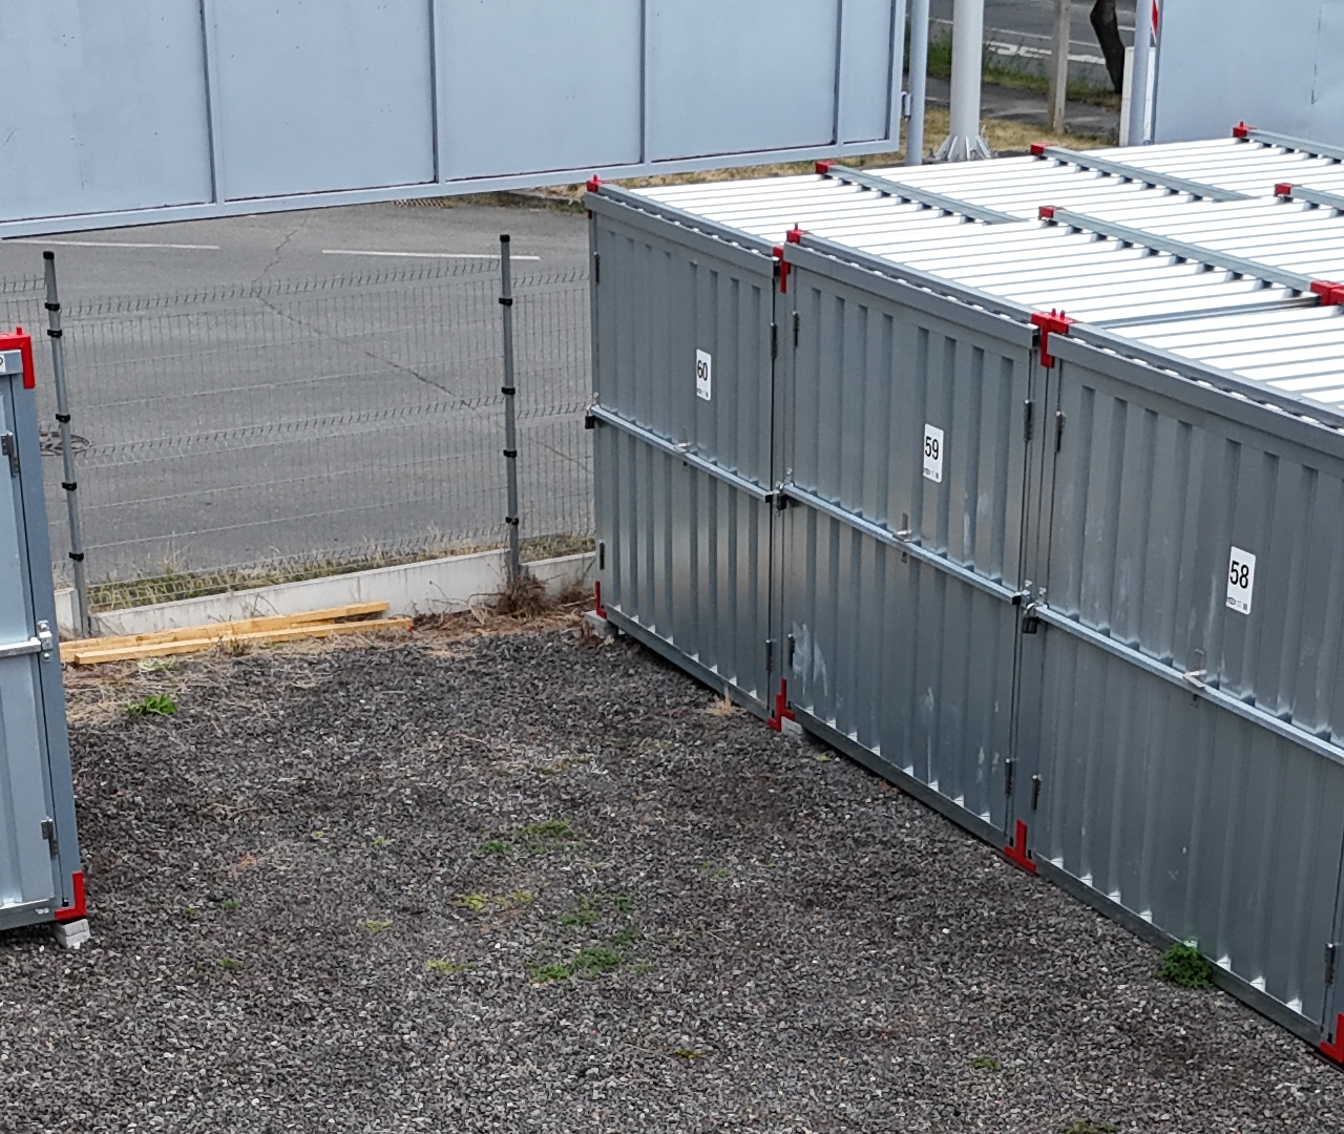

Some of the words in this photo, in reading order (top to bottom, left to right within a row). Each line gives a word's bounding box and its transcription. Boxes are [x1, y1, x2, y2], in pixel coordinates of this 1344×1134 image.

[696, 359, 708, 382] 60
[924, 435, 939, 461] 59
[1229, 560, 1250, 589] 58
